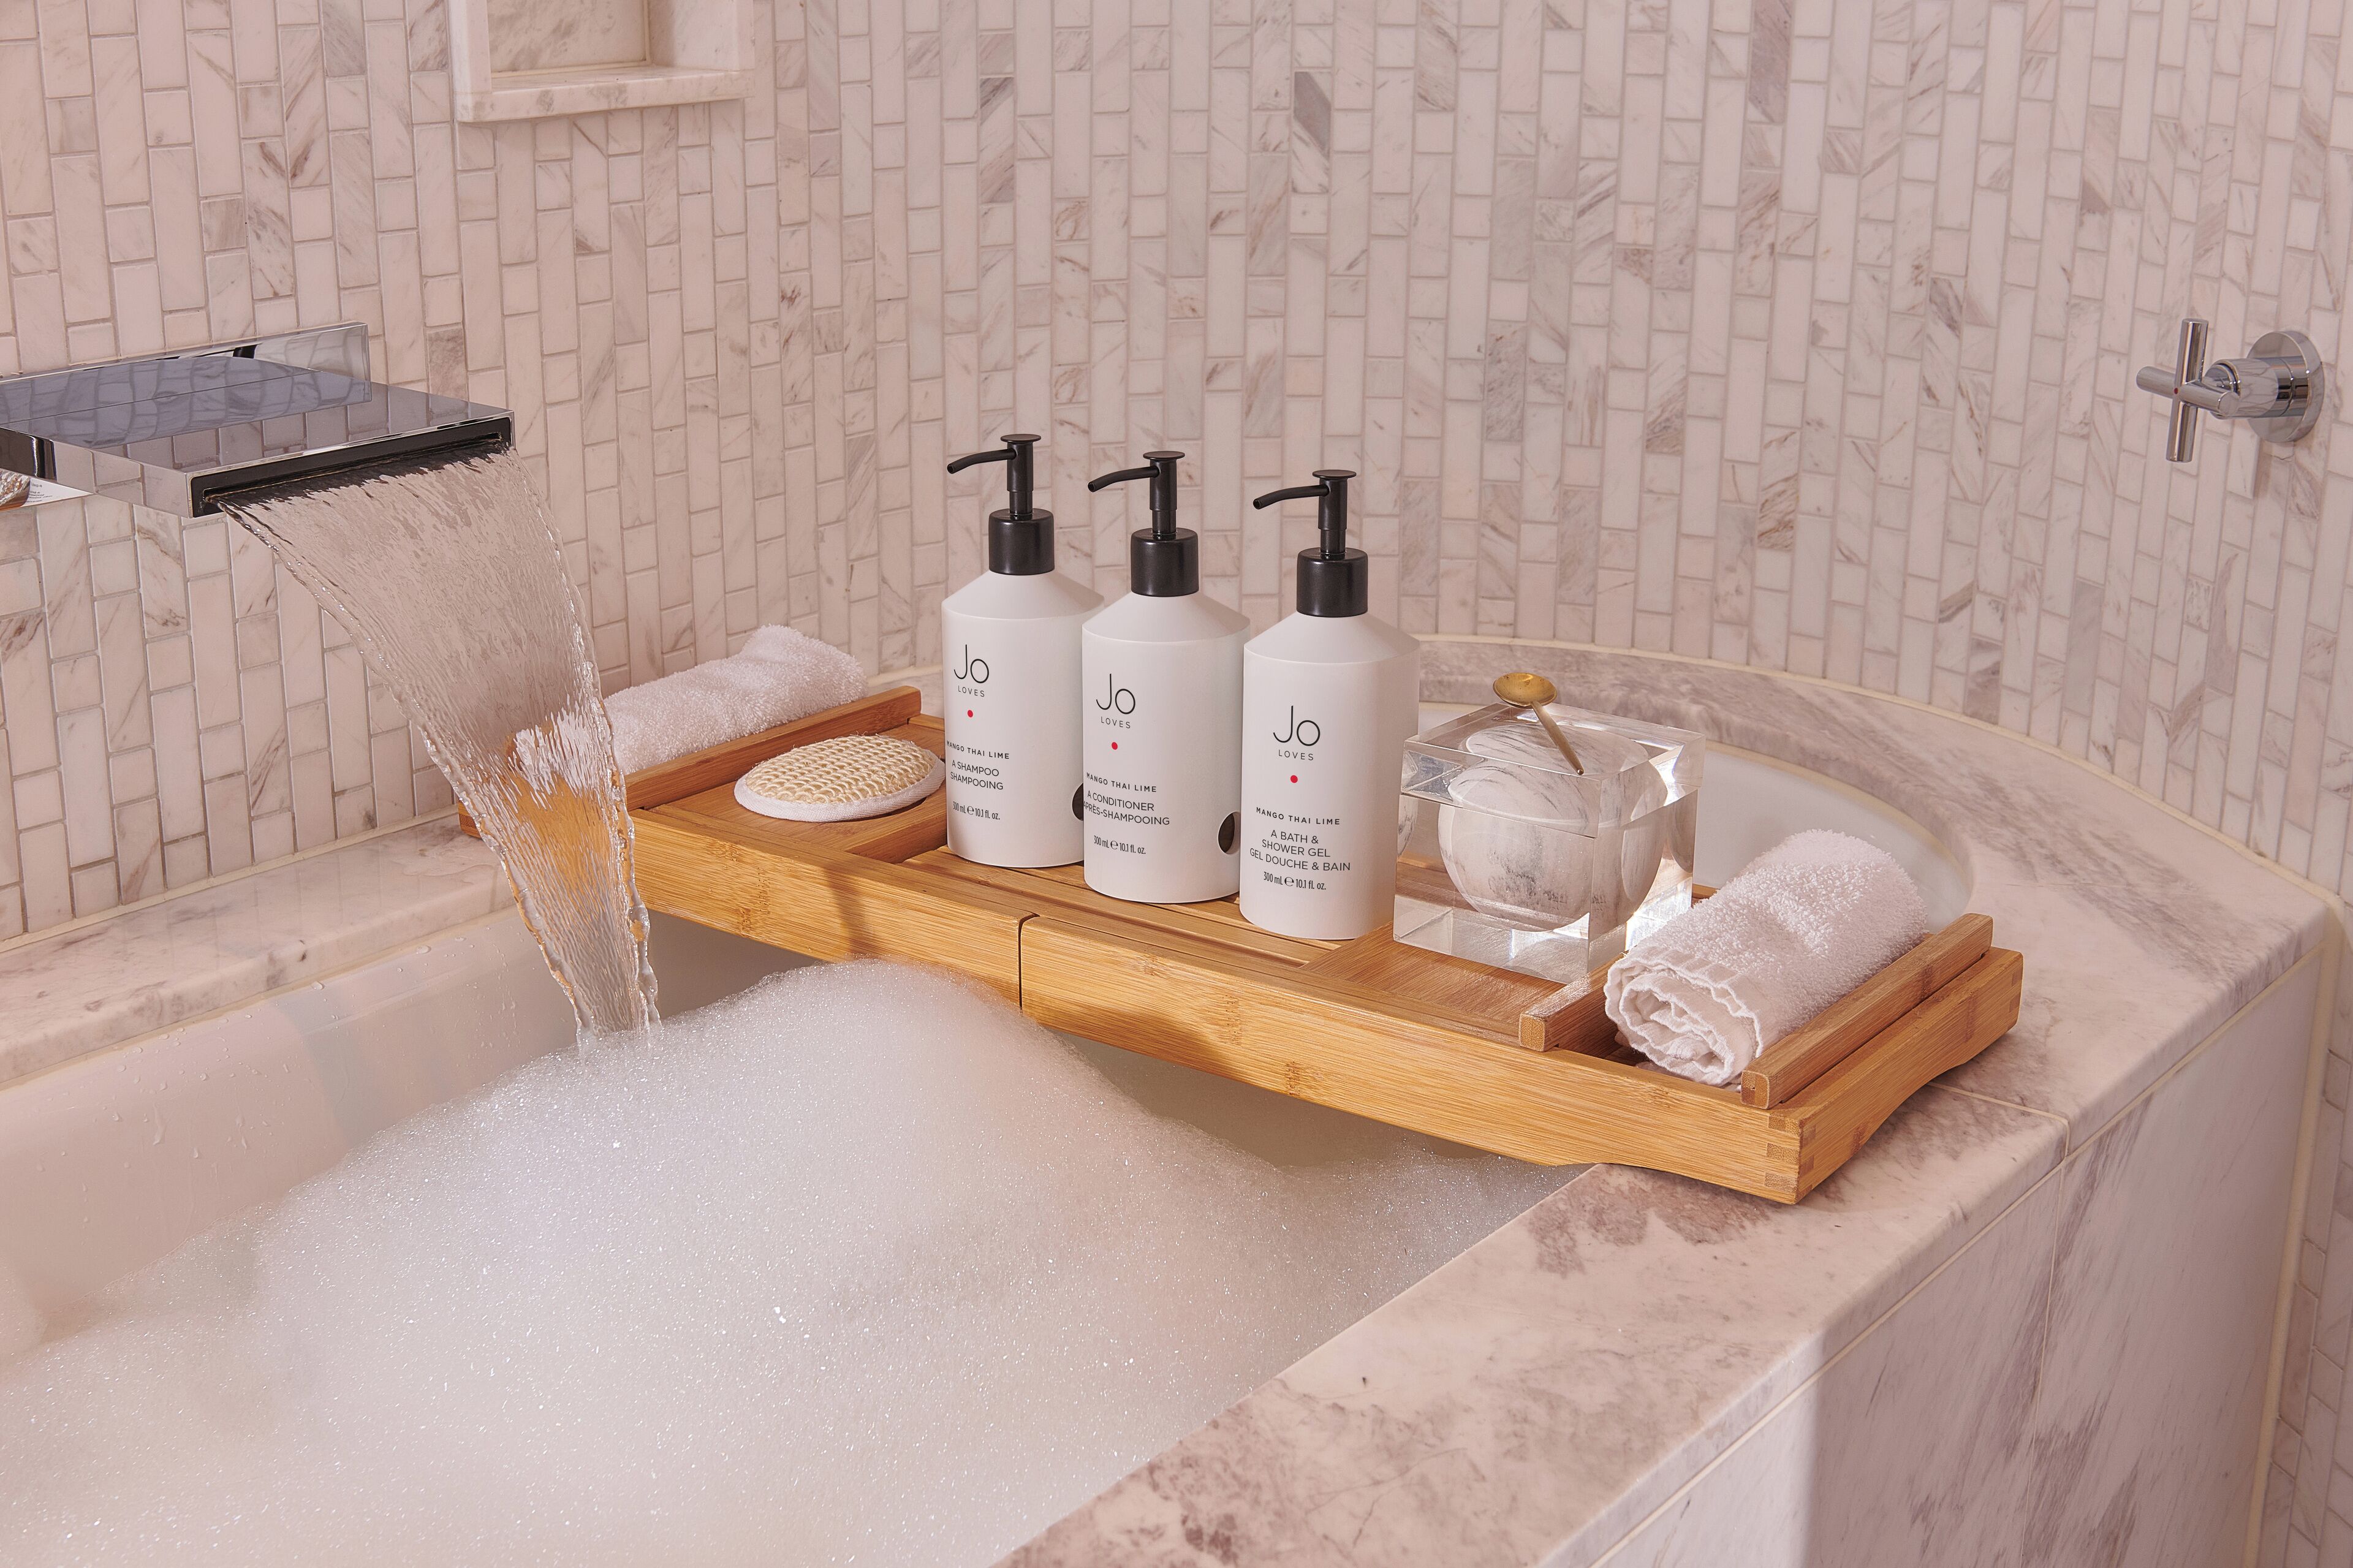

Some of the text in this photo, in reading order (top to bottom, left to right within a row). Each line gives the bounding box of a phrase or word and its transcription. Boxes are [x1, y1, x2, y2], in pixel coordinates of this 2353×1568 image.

[958, 685, 985, 697] LOVES
[1101, 716, 1131, 729] LOVES
[947, 740, 964, 752] MANGO
[968, 747, 985, 757] THAI
[1278, 749, 1314, 760] LOVES
[957, 762, 999, 776] SHAMPOO
[950, 771, 1003, 790] SHAMPOOING
[1086, 772, 1108, 785] MANGO
[1112, 780, 1131, 790] THAI
[1093, 792, 1154, 811] CONDITIONER
[1256, 807, 1284, 820] MANGO
[1289, 815, 1311, 824] THAI
[1281, 831, 1308, 843] BATH
[1311, 835, 1319, 844] &
[1262, 839, 1330, 857] SHOWER GEL
[1249, 849, 1351, 871] GEL DOUCHE & BAIN
